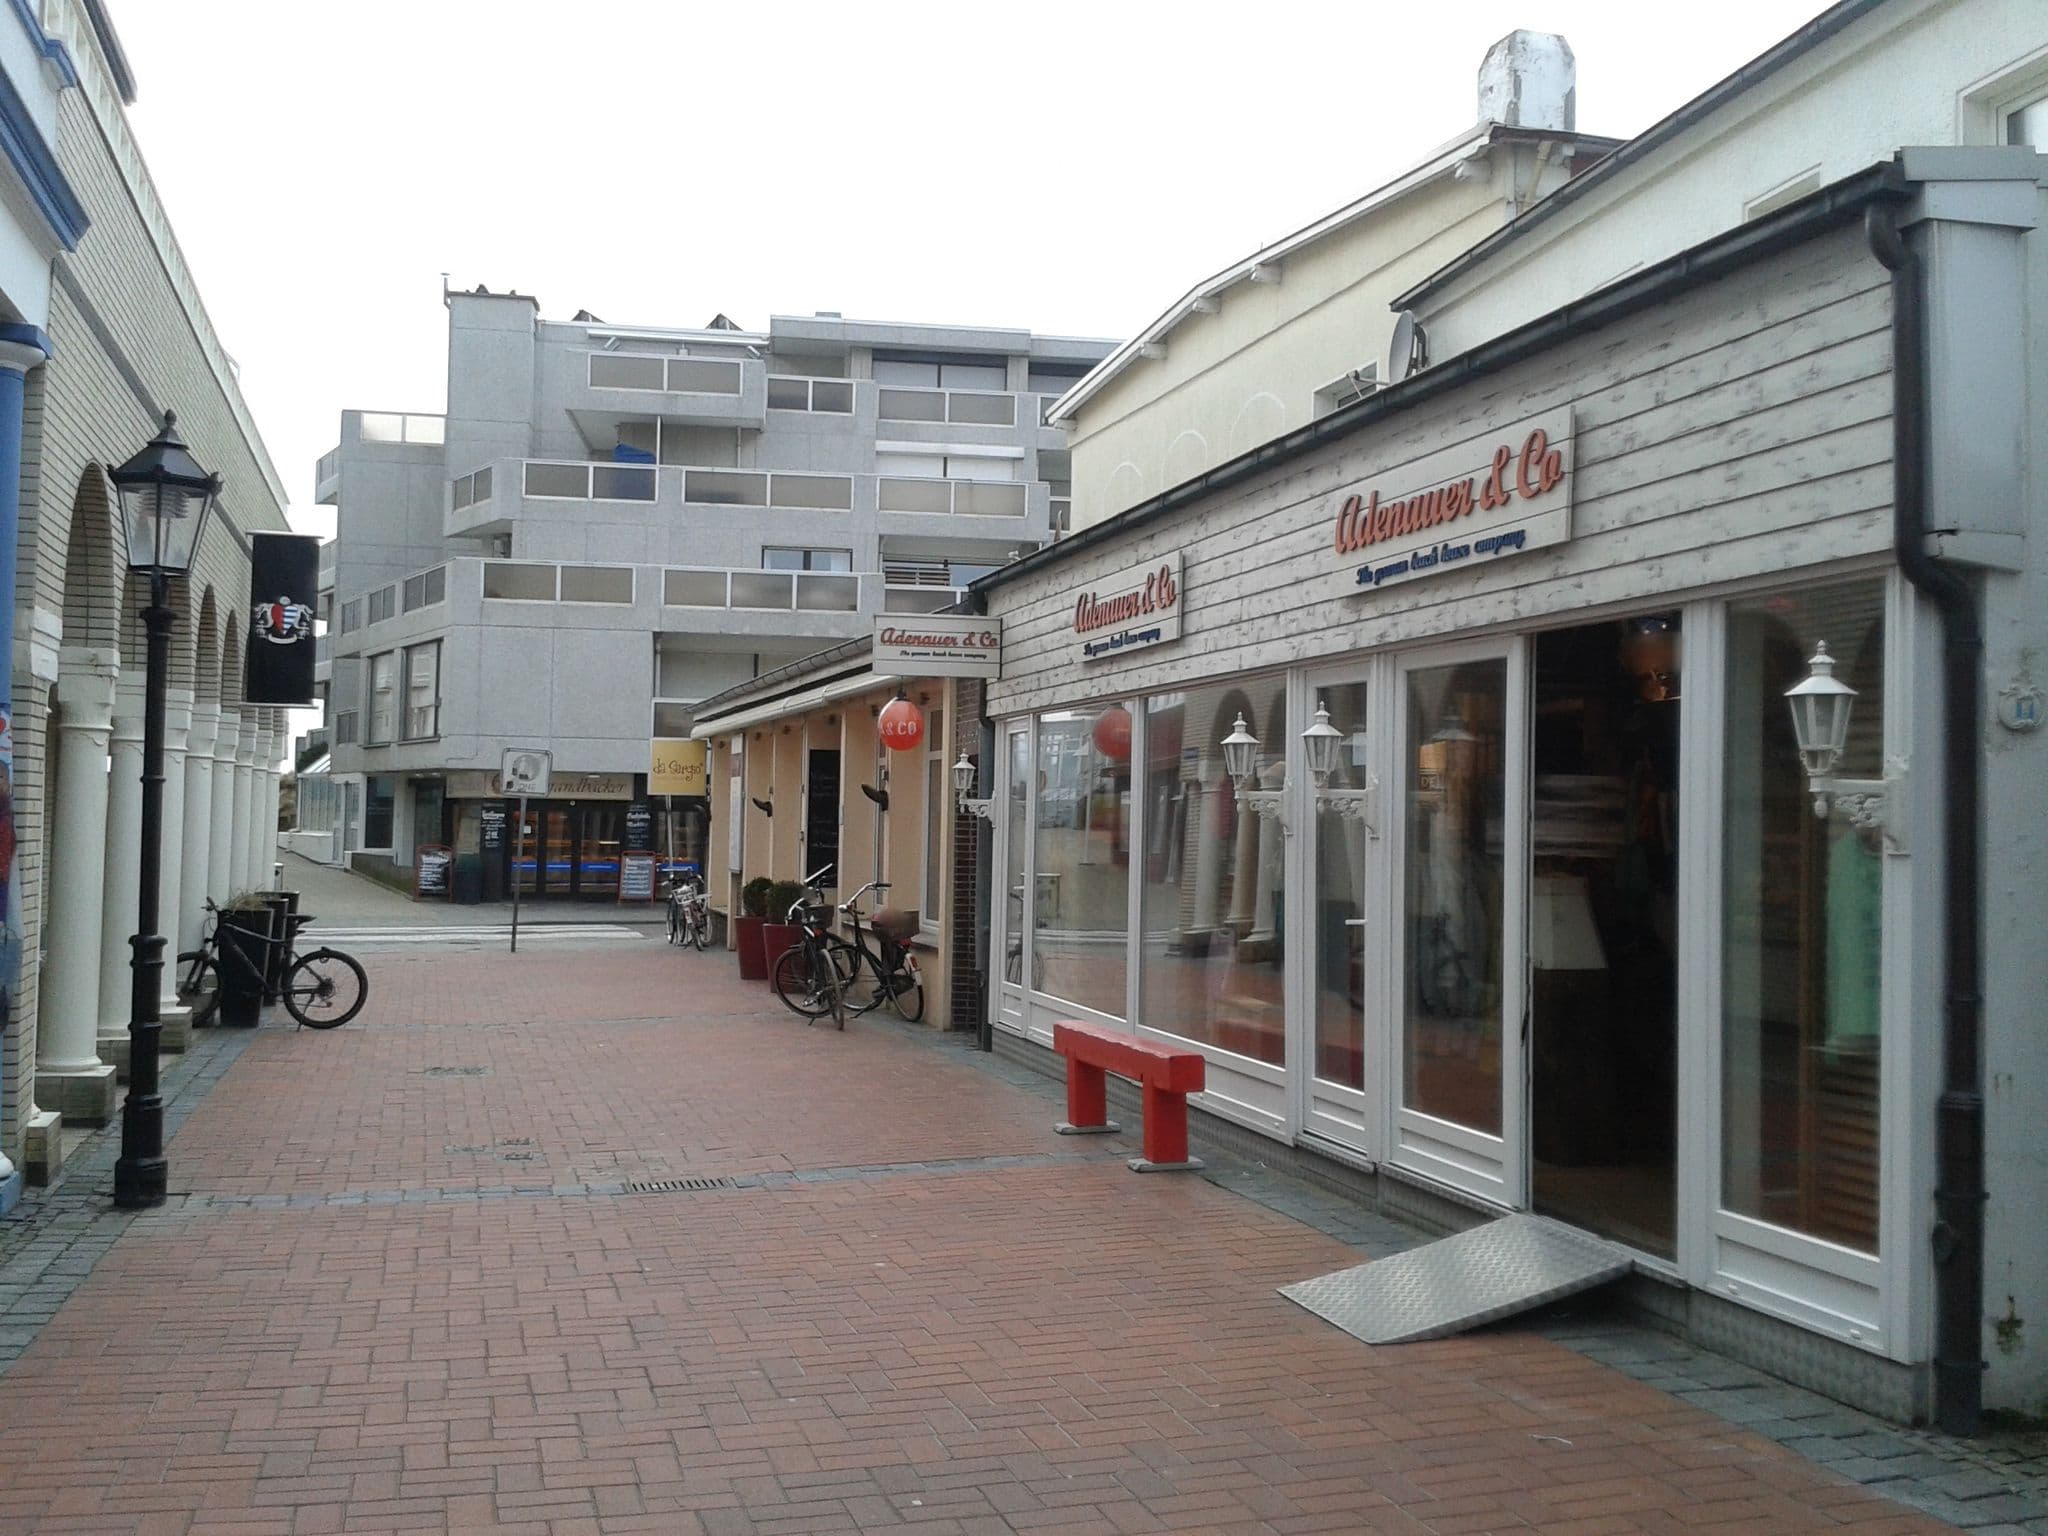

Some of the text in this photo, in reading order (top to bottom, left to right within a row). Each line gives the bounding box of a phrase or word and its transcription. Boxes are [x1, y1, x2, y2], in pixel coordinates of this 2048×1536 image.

[1335, 428, 1565, 553] Adenauer & Co
[1074, 564, 1177, 633] Adenauer & Co
[881, 627, 998, 648] Adenauer & Co
[897, 721, 917, 736] CO
